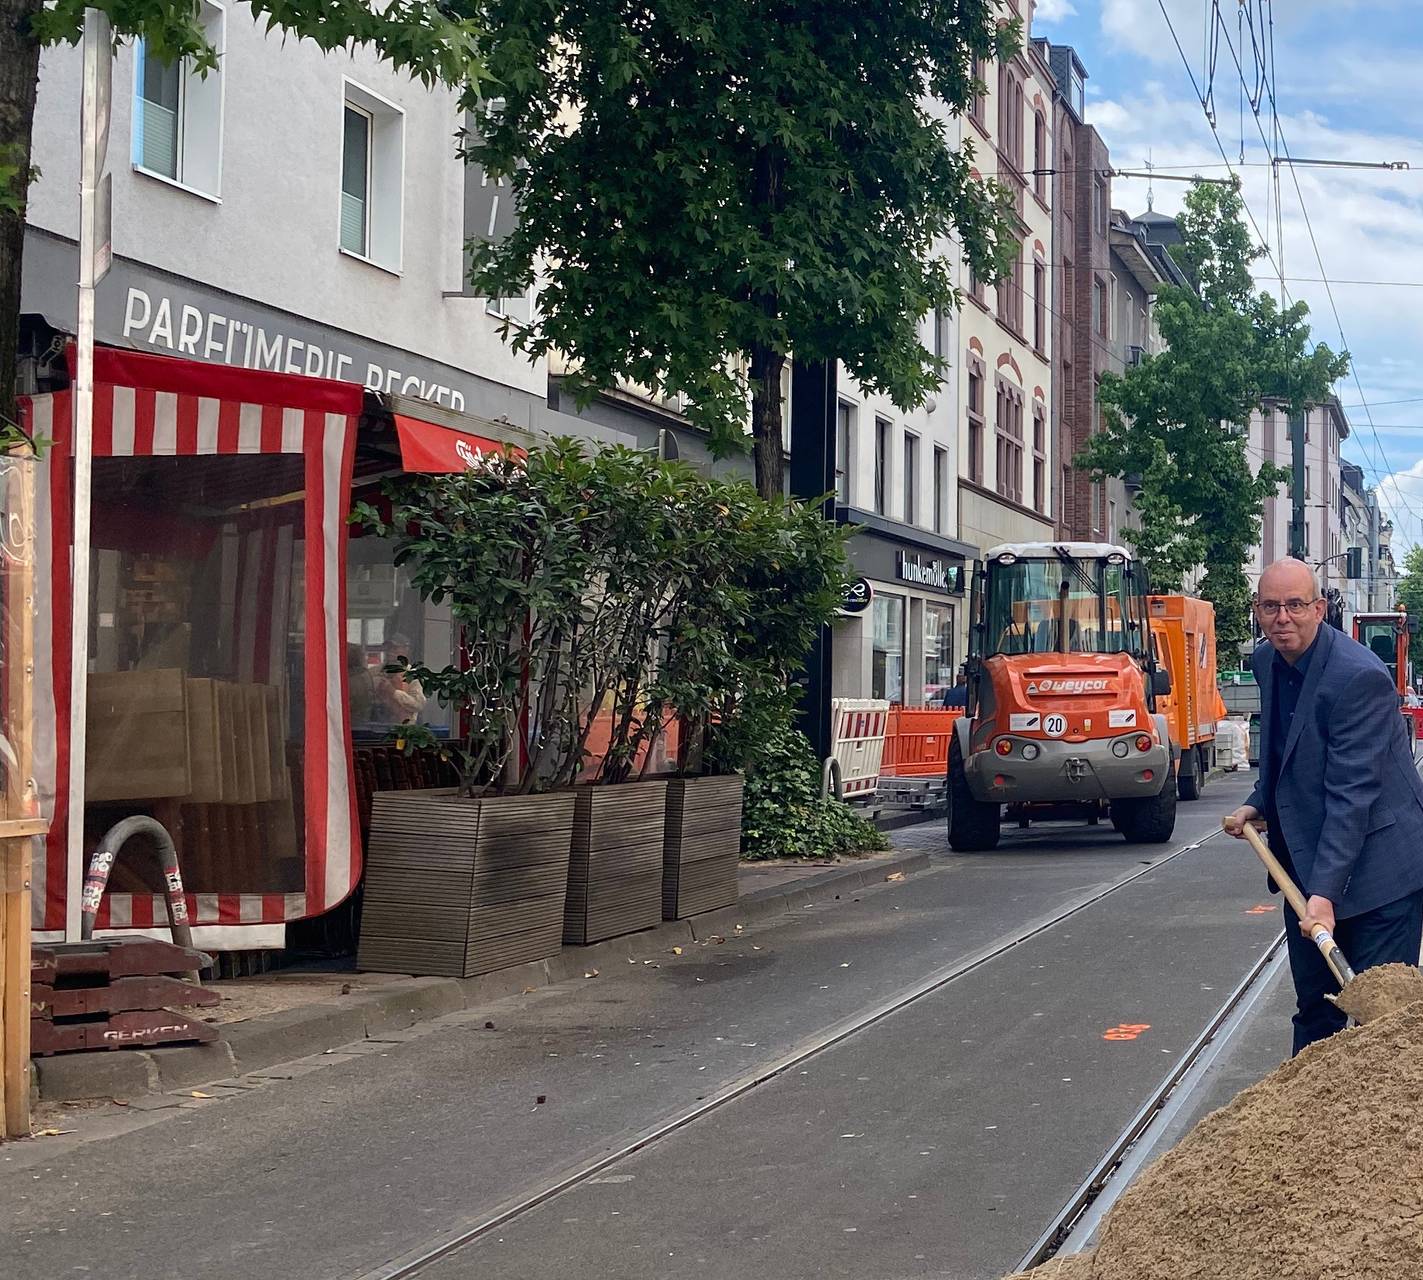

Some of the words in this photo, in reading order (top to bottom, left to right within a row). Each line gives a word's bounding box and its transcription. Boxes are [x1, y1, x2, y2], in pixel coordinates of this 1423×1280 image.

[902, 550, 948, 588] hunkemölle
[1052, 680, 1108, 693] weycor
[1048, 718, 1063, 732] 20
